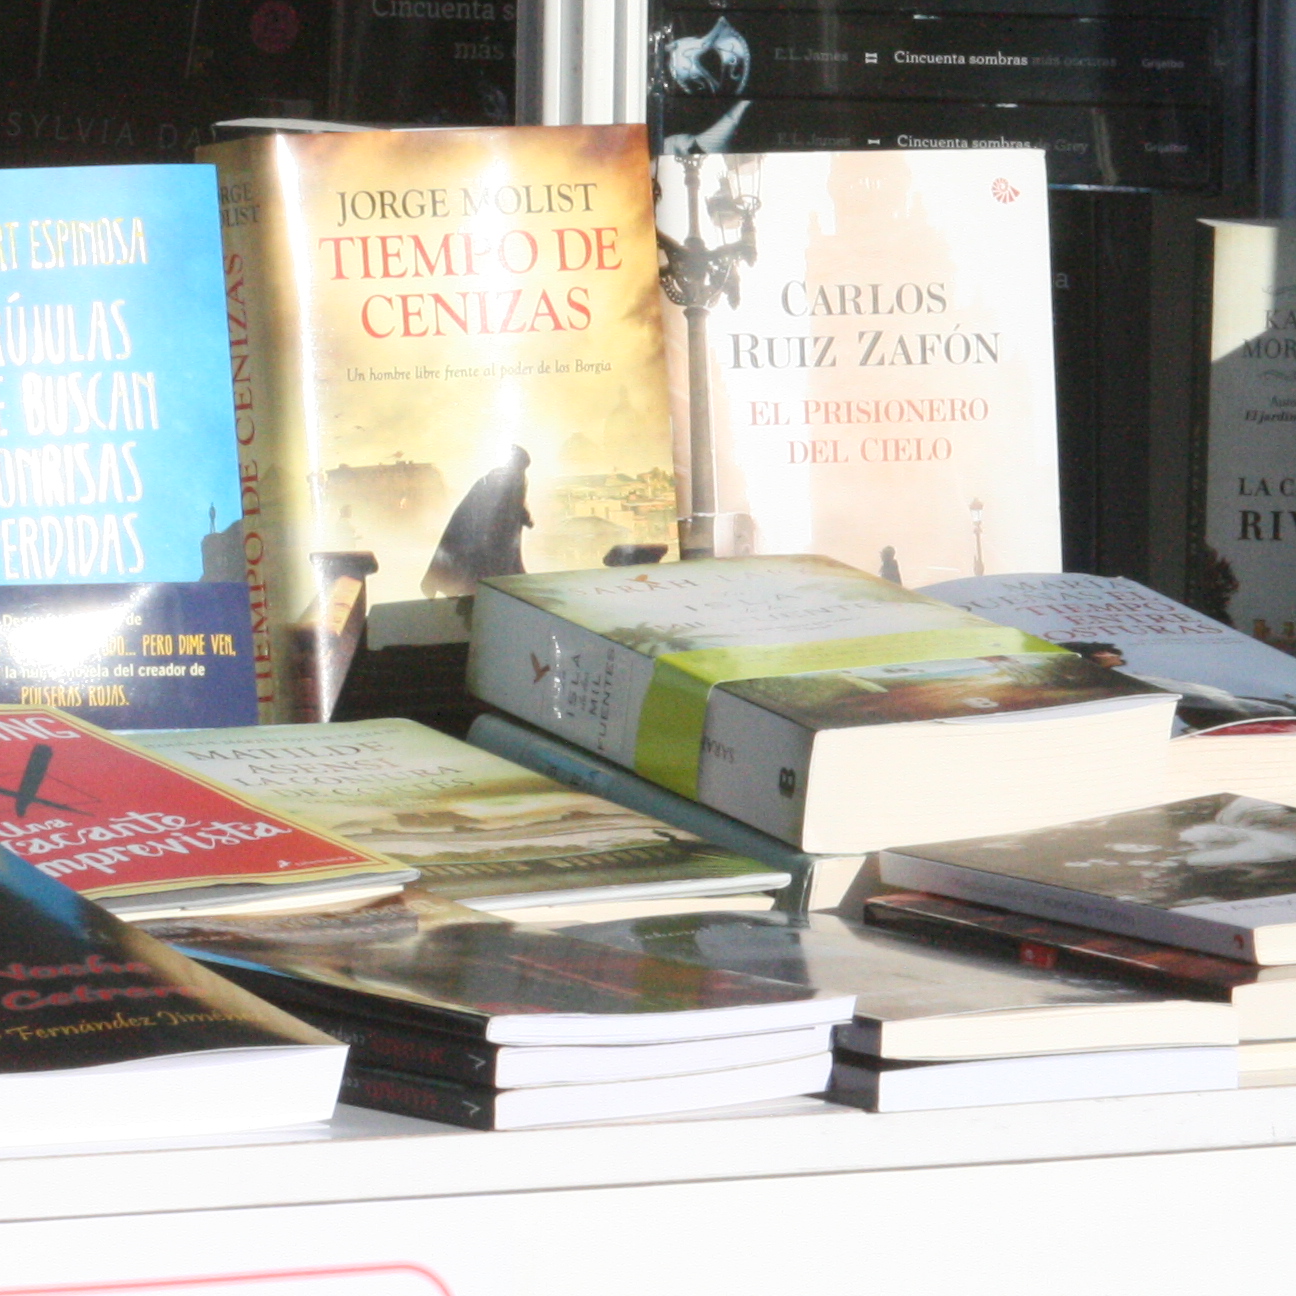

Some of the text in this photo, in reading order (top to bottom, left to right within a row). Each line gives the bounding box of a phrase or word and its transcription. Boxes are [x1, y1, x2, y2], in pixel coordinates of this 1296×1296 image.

[453, 34, 505, 62] más
[802, 48, 1185, 71] James Cincuenta sombras Grijalbo
[4, 109, 138, 148] SYLVIA
[896, 134, 970, 150] Cincuenta
[972, 135, 1031, 150] sombras
[1054, 138, 1089, 156] Grey
[336, 182, 599, 228] JORGE MOLIST
[28, 216, 148, 269] ESPINOSA
[317, 226, 624, 282] TIEMPO DE
[780, 278, 948, 318] CARLOS
[360, 285, 593, 340] CENIZAS
[727, 324, 1002, 371] RUIZ ZAFÓN
[346, 367, 367, 383] Un
[369, 365, 411, 383] hombre
[414, 365, 441, 381] libre
[444, 363, 479, 382] frente
[483, 363, 497, 378] al
[537, 360, 551, 376] de
[554, 359, 571, 375] los
[574, 357, 612, 378] Borgia
[21, 370, 161, 436] BUSCAN
[748, 396, 990, 427] EL PRISIONERO
[786, 436, 953, 465] DEL CIELO
[223, 252, 275, 706] TIEMPO DE CENIZAS
[1237, 477, 1272, 497] LA
[125, 612, 142, 626] de
[142, 634, 173, 657] PERO
[178, 633, 206, 657] DIME
[210, 633, 237, 658] VEN,
[5, 665, 17, 679] la
[113, 662, 134, 678] del
[138, 662, 186, 679] creador
[189, 662, 206, 677] de
[20, 684, 130, 708] PULSERAS ROJAS.
[182, 739, 395, 762] MATILDE
[248, 756, 401, 776] ASENSI
[231, 775, 284, 788] LA
[5, 1011, 156, 1042] Fernández
